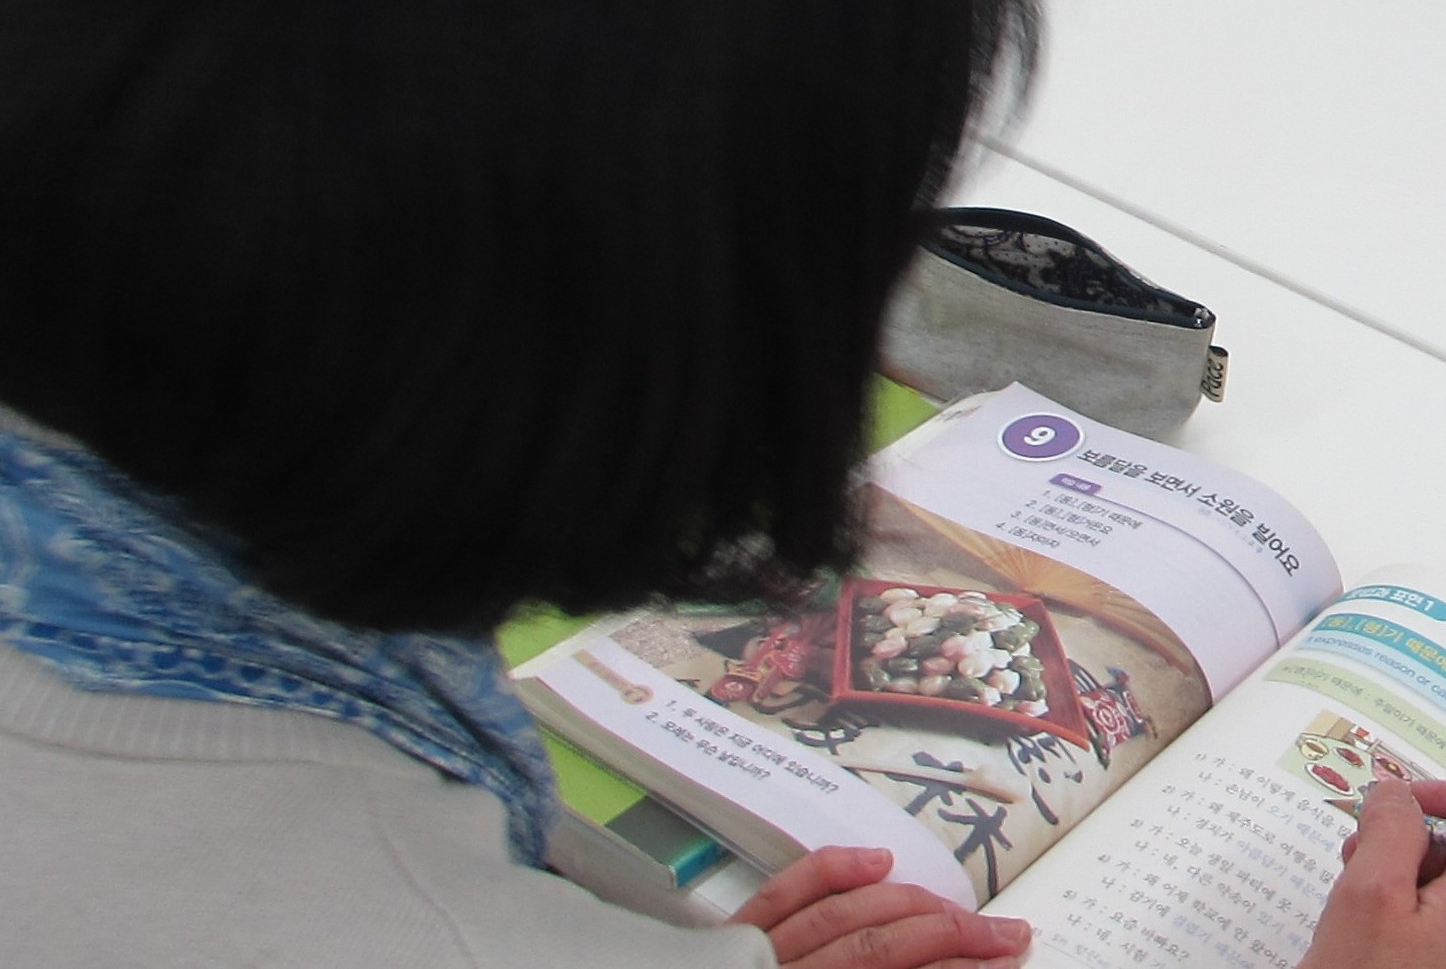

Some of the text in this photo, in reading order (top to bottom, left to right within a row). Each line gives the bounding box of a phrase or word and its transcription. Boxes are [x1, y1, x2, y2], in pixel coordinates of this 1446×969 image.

[1023, 425, 1057, 447] 9
[1077, 448, 1148, 479] 보름달을
[1143, 470, 1201, 499] 보면서
[1197, 492, 1255, 528] 소원을
[1251, 522, 1300, 577] 빌어요
[1389, 589, 1424, 607] 표현
[1374, 652, 1417, 678] reason
[1416, 675, 1431, 685] or
[1255, 775, 1297, 803] 이렇게
[1296, 798, 1335, 828] 음식을
[1248, 938, 1290, 969] 왔어요
